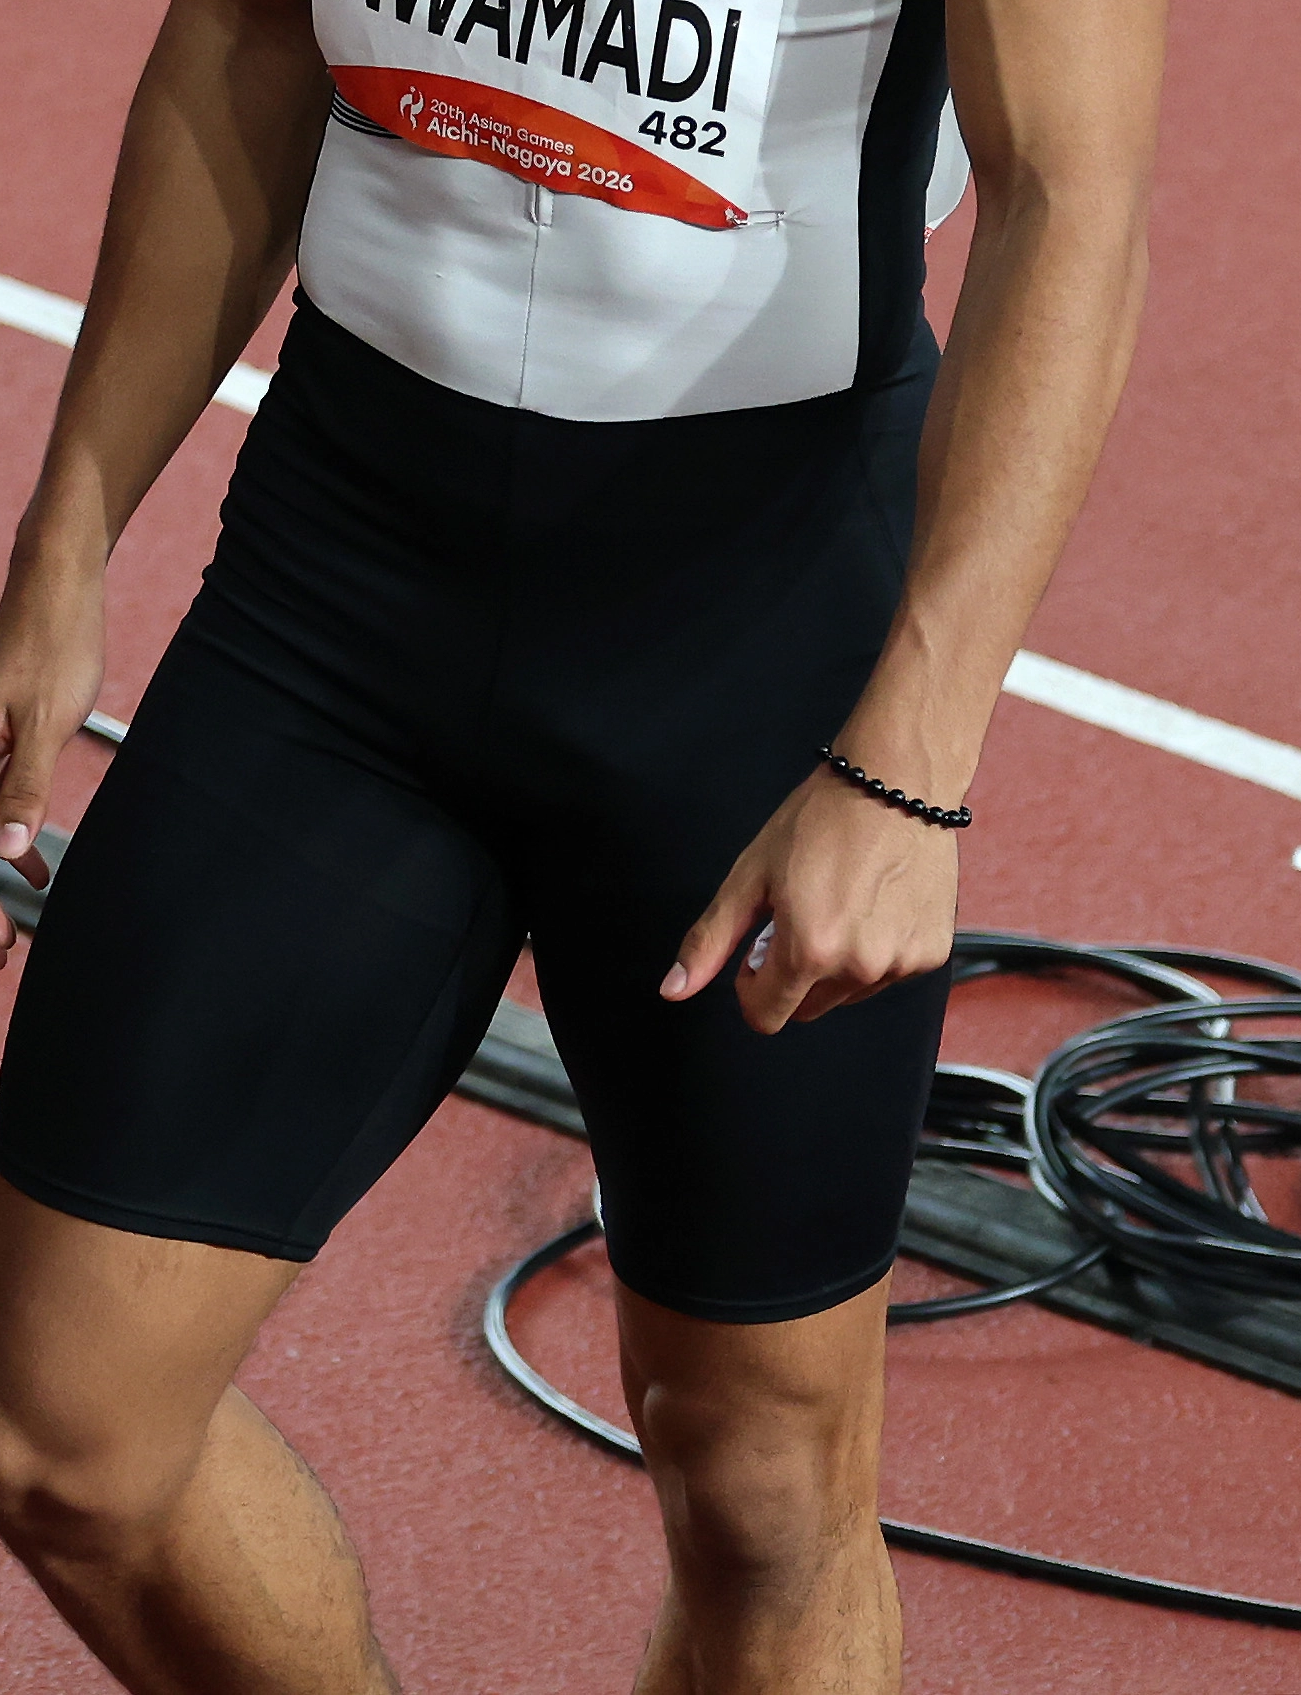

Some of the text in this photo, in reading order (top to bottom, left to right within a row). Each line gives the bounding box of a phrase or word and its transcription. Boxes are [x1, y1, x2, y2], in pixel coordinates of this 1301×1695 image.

[426, 116, 635, 193] Aichi-Nagoya 2026
[430, 99, 575, 156] 20th Asian Games
[637, 109, 728, 158] 482
